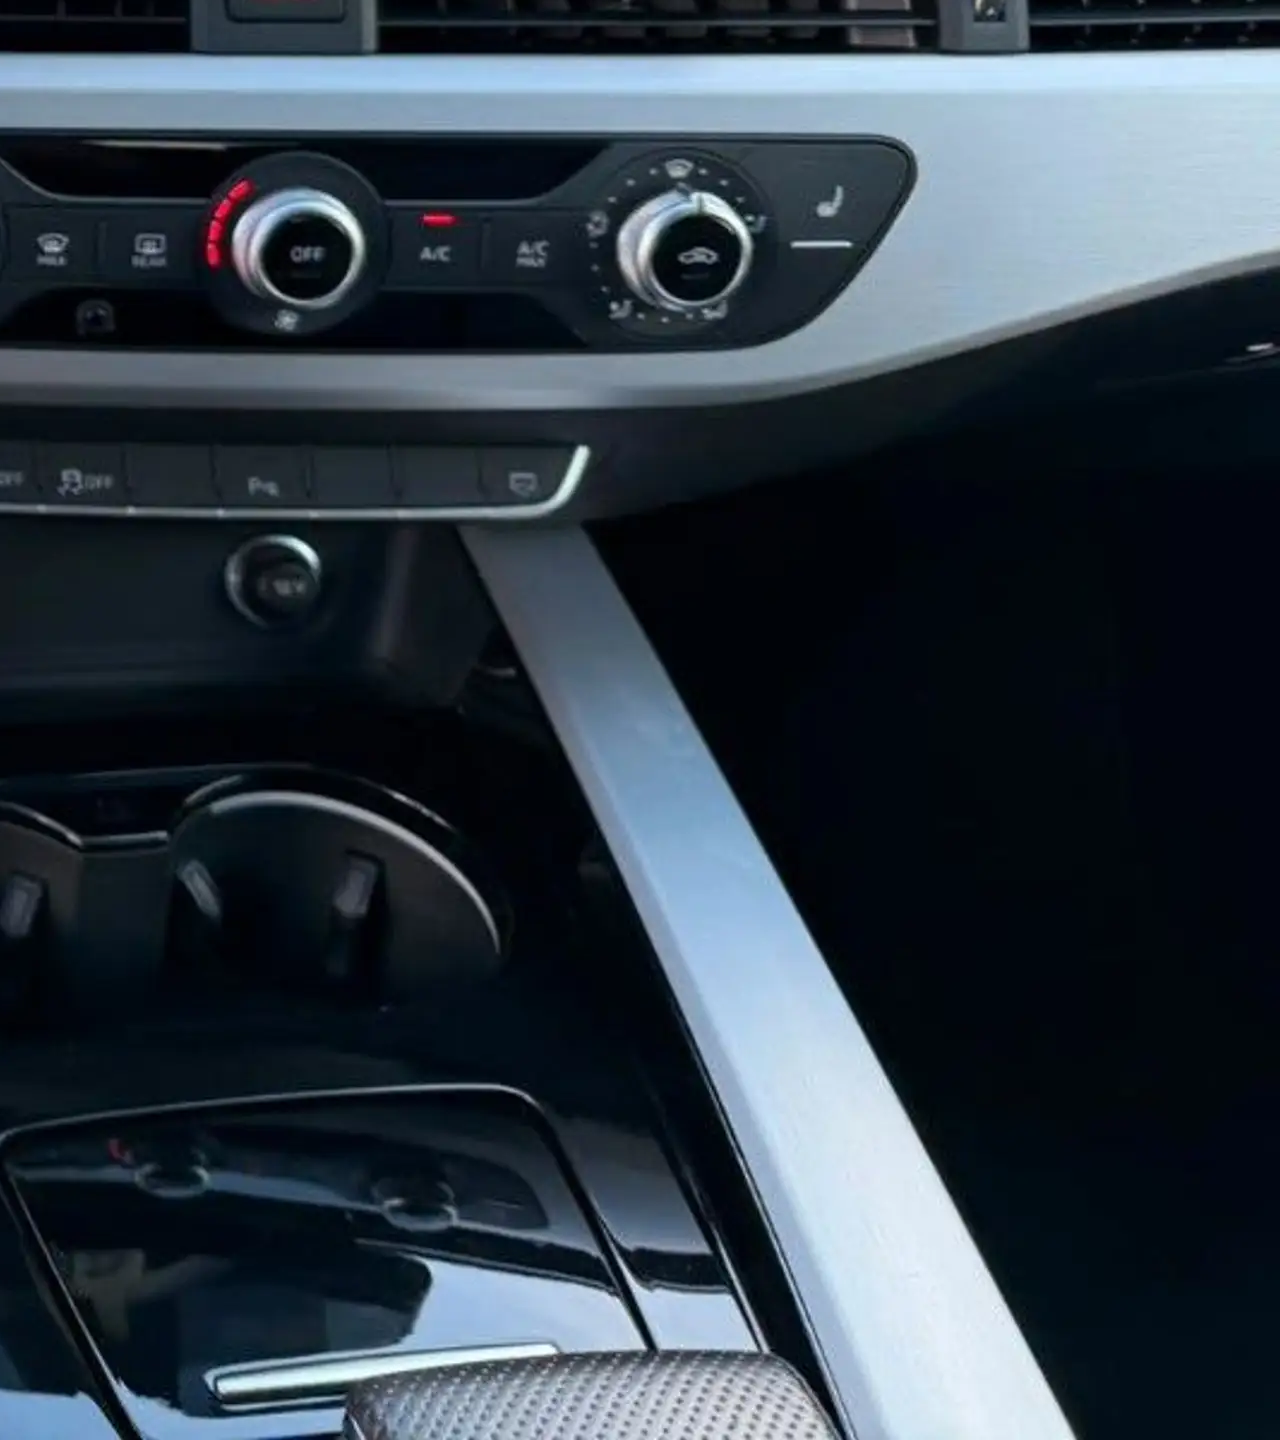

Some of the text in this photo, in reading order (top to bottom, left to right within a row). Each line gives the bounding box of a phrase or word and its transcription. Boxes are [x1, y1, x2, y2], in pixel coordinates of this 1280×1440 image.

[290, 246, 325, 263] OFF
[420, 246, 452, 262] A/C
[517, 240, 550, 257] A/C
